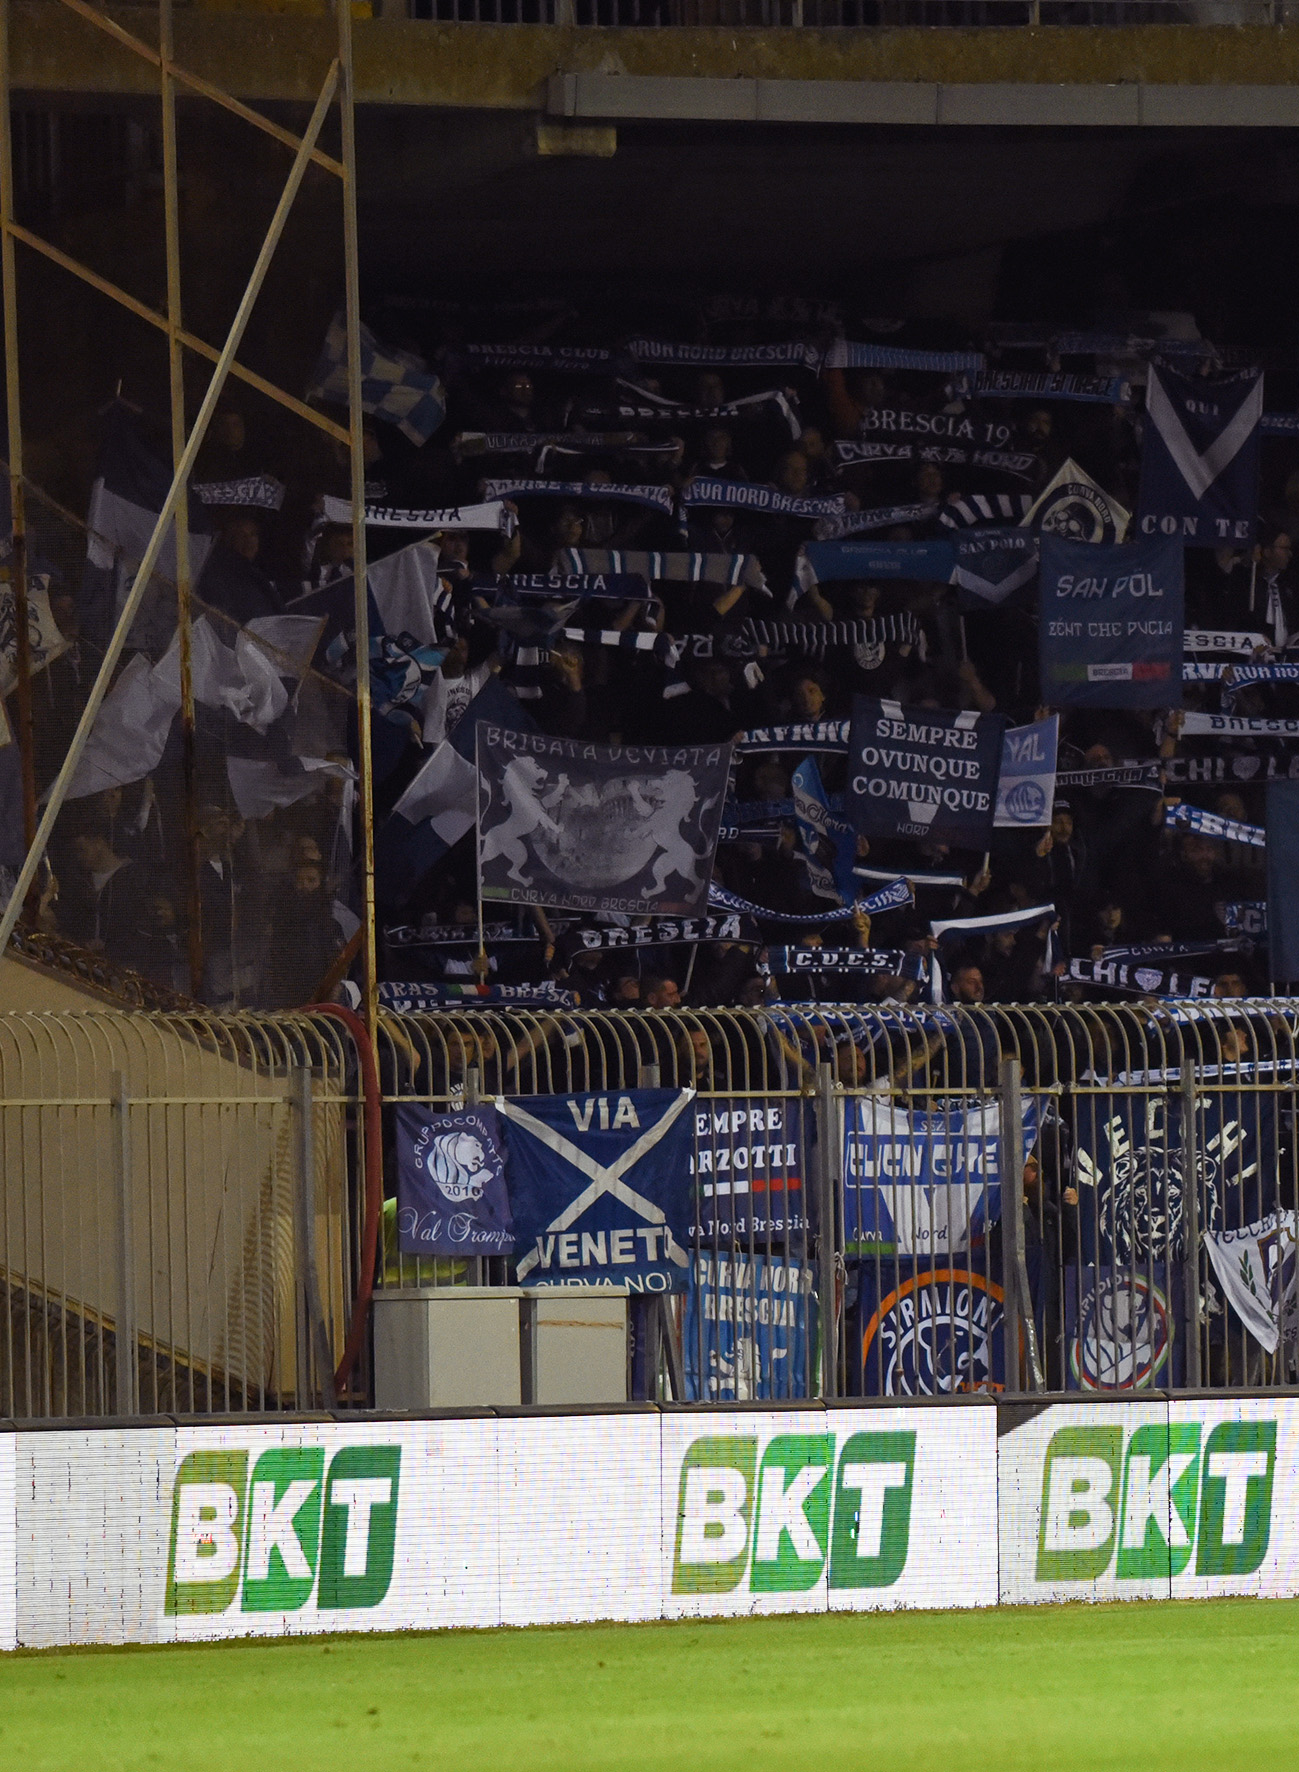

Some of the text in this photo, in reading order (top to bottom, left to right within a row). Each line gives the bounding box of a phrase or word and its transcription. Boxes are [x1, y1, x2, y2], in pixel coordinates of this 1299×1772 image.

[467, 343, 610, 361] BRESCIA CLUB
[867, 409, 975, 441] BRESCIA
[1140, 514, 1250, 539] CON TE
[1055, 574, 1108, 599] SAN
[1087, 621, 1123, 638] CHE
[486, 725, 598, 761] BRIGATA
[875, 717, 979, 751] SEMPRE
[861, 746, 982, 781] OVUNQUE
[851, 777, 990, 813] COMUNQUE
[896, 822, 930, 837] NORD
[566, 1096, 641, 1132] VIA
[444, 1182, 482, 1197] 2010
[396, 1206, 443, 1243] Val
[678, 1458, 909, 1567] BKT
[1042, 1449, 1270, 1555] BKT
[176, 1476, 394, 1586] BKT
